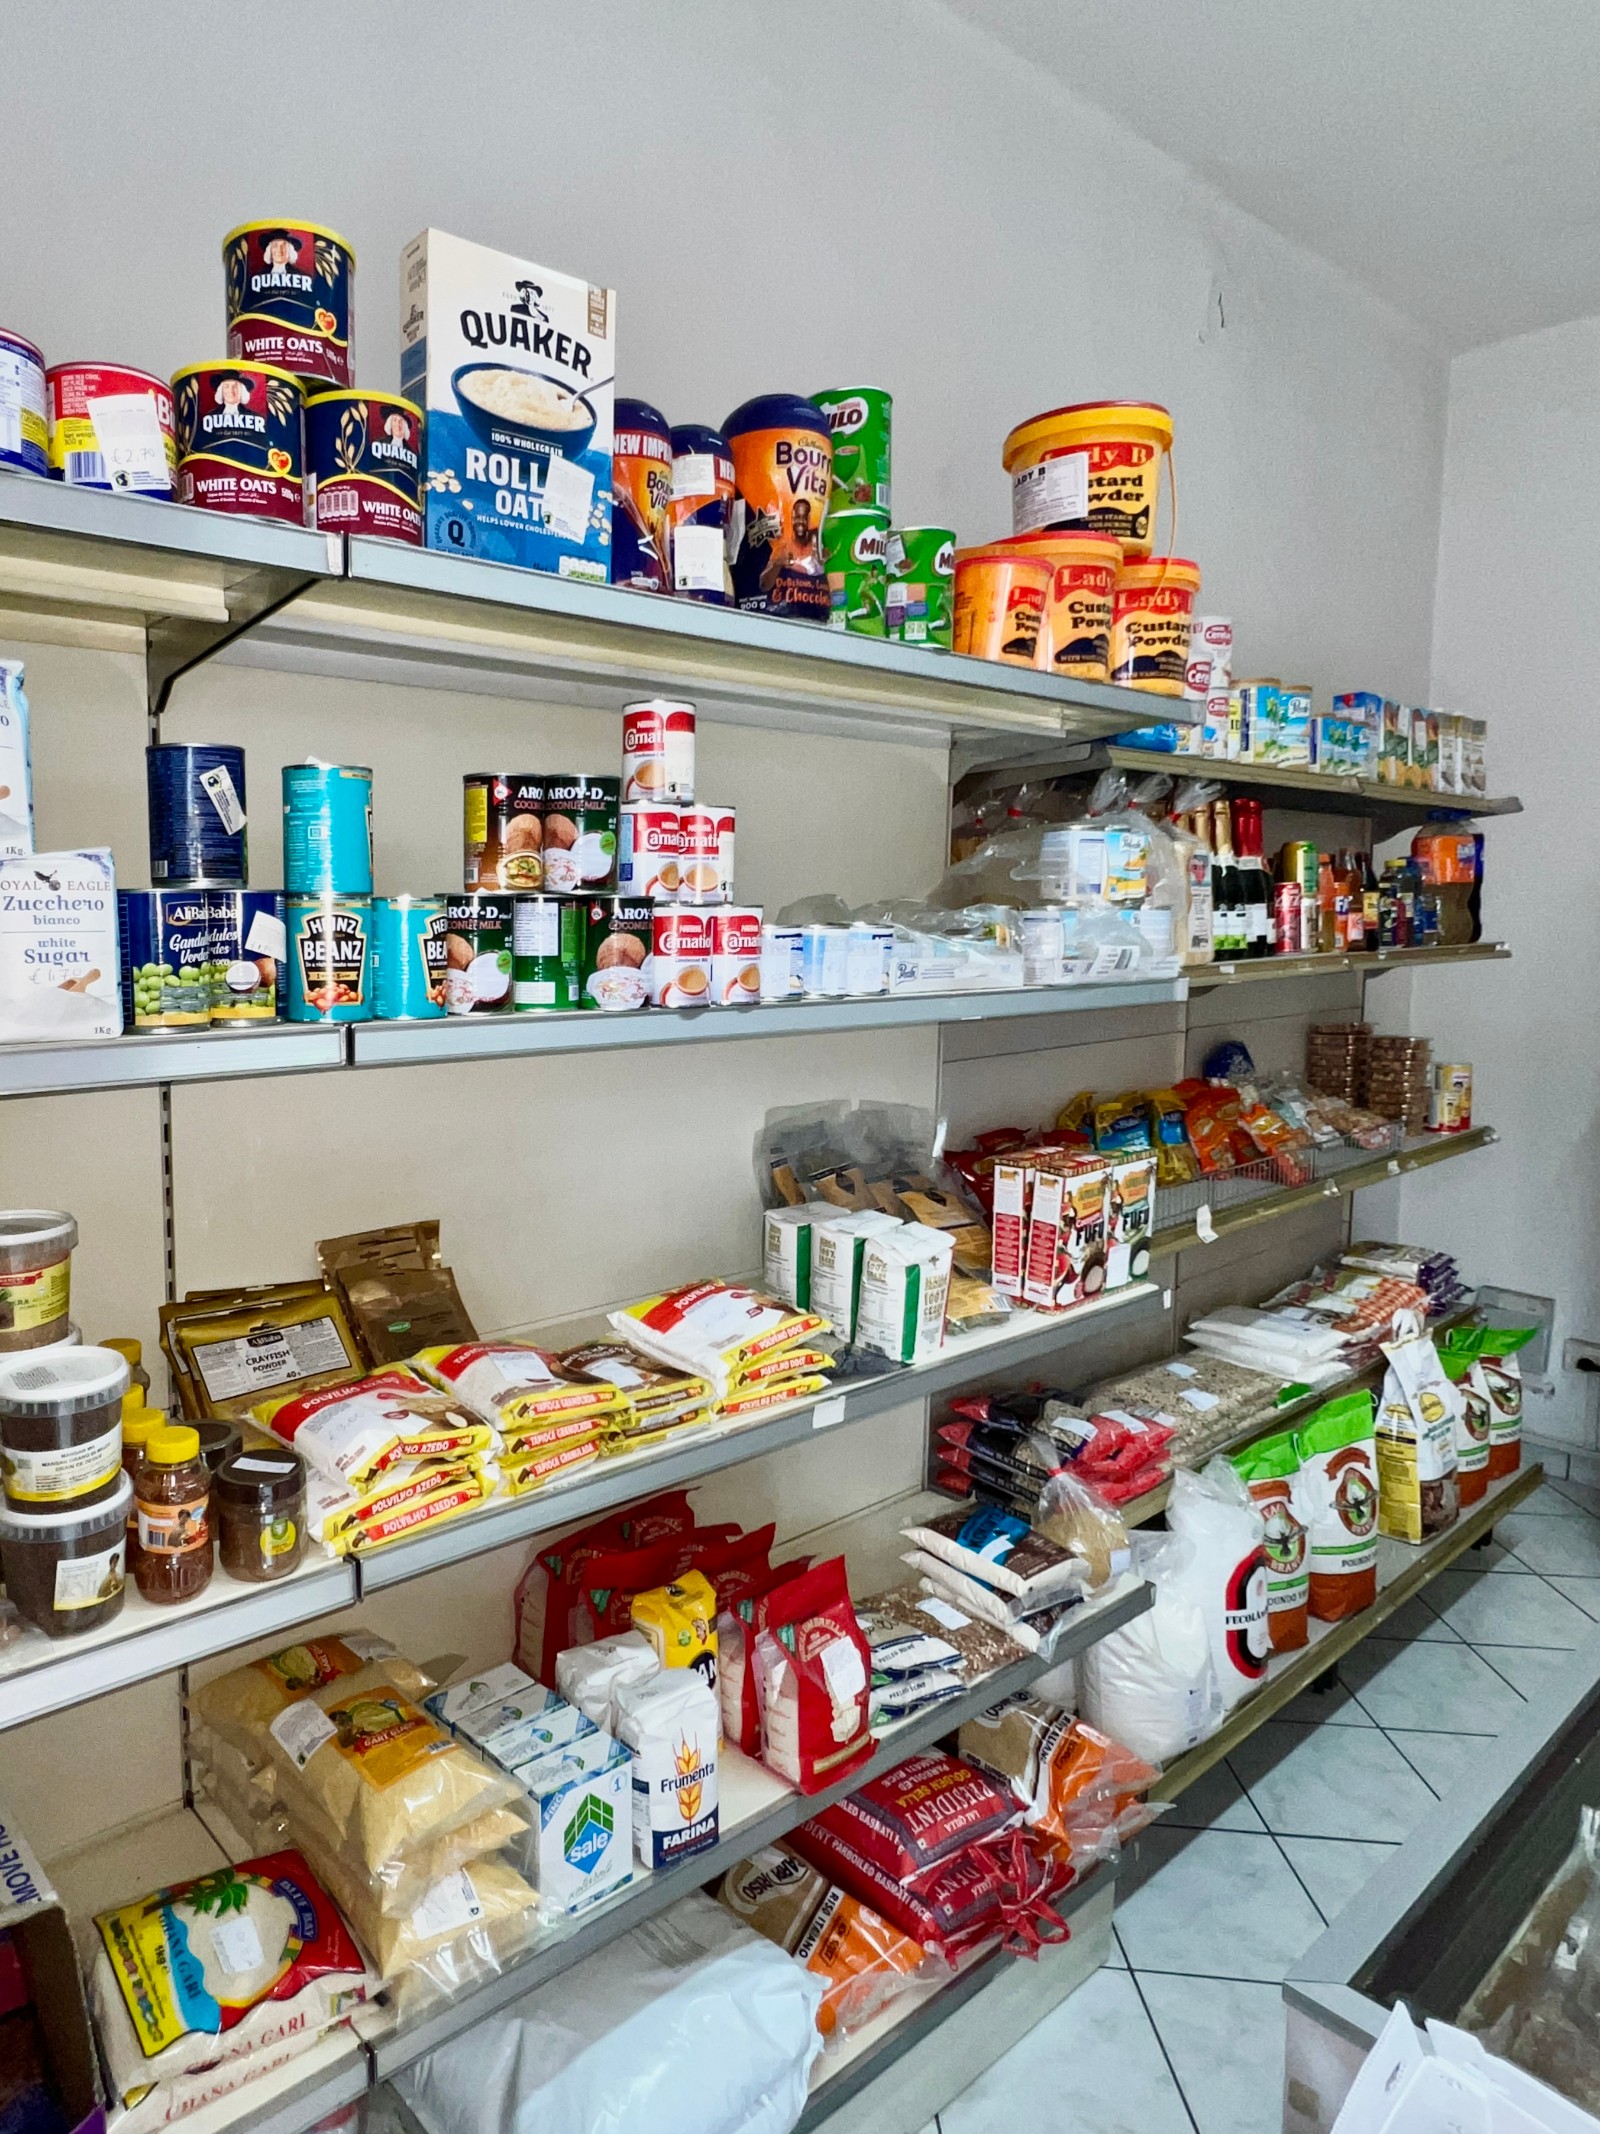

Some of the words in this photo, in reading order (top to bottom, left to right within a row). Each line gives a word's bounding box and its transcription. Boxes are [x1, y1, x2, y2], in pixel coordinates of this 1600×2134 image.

[251, 273, 313, 292] QUAKER
[245, 337, 284, 352] WHITE
[287, 337, 323, 354] OATS
[459, 309, 592, 379] QUAKER
[202, 413, 266, 433] QUAKER
[828, 409, 863, 429] ILO
[491, 432, 512, 445] 100%
[513, 434, 563, 457] WHOLEGRAIN
[371, 441, 418, 469] QUAKER
[1131, 446, 1147, 464] B
[466, 448, 547, 494] ROLL
[787, 465, 827, 497] Vita
[196, 477, 238, 492] WHITE
[240, 478, 277, 494] OATS
[1088, 475, 1144, 489] stard
[1088, 489, 1144, 503] wder
[362, 501, 401, 518] WHITE
[476, 515, 498, 525] HELPS
[500, 519, 524, 531] LOWER
[740, 600, 758, 609] 900
[1117, 591, 1182, 613] Lady
[547, 787, 603, 800] AROY-D
[0, 880, 42, 892] OYAL
[67, 880, 111, 892] EAGLE
[3, 895, 104, 912] Zucchero
[448, 906, 498, 919] ROY-D
[33, 914, 81, 926] bianco
[37, 937, 76, 948] white
[303, 940, 362, 960] BEANZ
[427, 940, 448, 960] BEA
[659, 931, 711, 954] Carnatio
[24, 948, 91, 967] Sugar
[1122, 1206, 1150, 1232] FUFU
[673, 1283, 715, 1310] POLVILHO
[245, 1350, 291, 1367] CRAYFISH
[252, 1359, 287, 1373] POWDER
[301, 1385, 361, 1410] POLVILHO
[420, 1440, 450, 1454] AZEDO
[534, 1457, 560, 1474] TAPIOCA
[371, 1487, 414, 1515] POLVILHO
[415, 1475, 442, 1496] AZEDO
[382, 1508, 428, 1536] POLVILHO
[428, 1496, 459, 1519] AZEDO
[1267, 1593, 1297, 1606] OUNDO
[697, 1659, 716, 1680] AN
[364, 1733, 389, 1748] GARI
[614, 1777, 622, 1792] 1
[660, 1763, 715, 1793] Frumenta
[896, 1785, 931, 1808] SELLA
[905, 1779, 995, 1835] PRESIDENT
[662, 1816, 716, 1850] FARINA
[858, 1811, 895, 1843] BASMATI
[569, 1832, 609, 1864] sale
[0, 1848, 41, 1904] MOVE
[831, 1839, 875, 1876] PARBOILED
[874, 1871, 910, 1903] BASMATI
[909, 1900, 933, 1922] RICE
[821, 1891, 839, 1916] RISO
[177, 1959, 202, 2000] GARI
